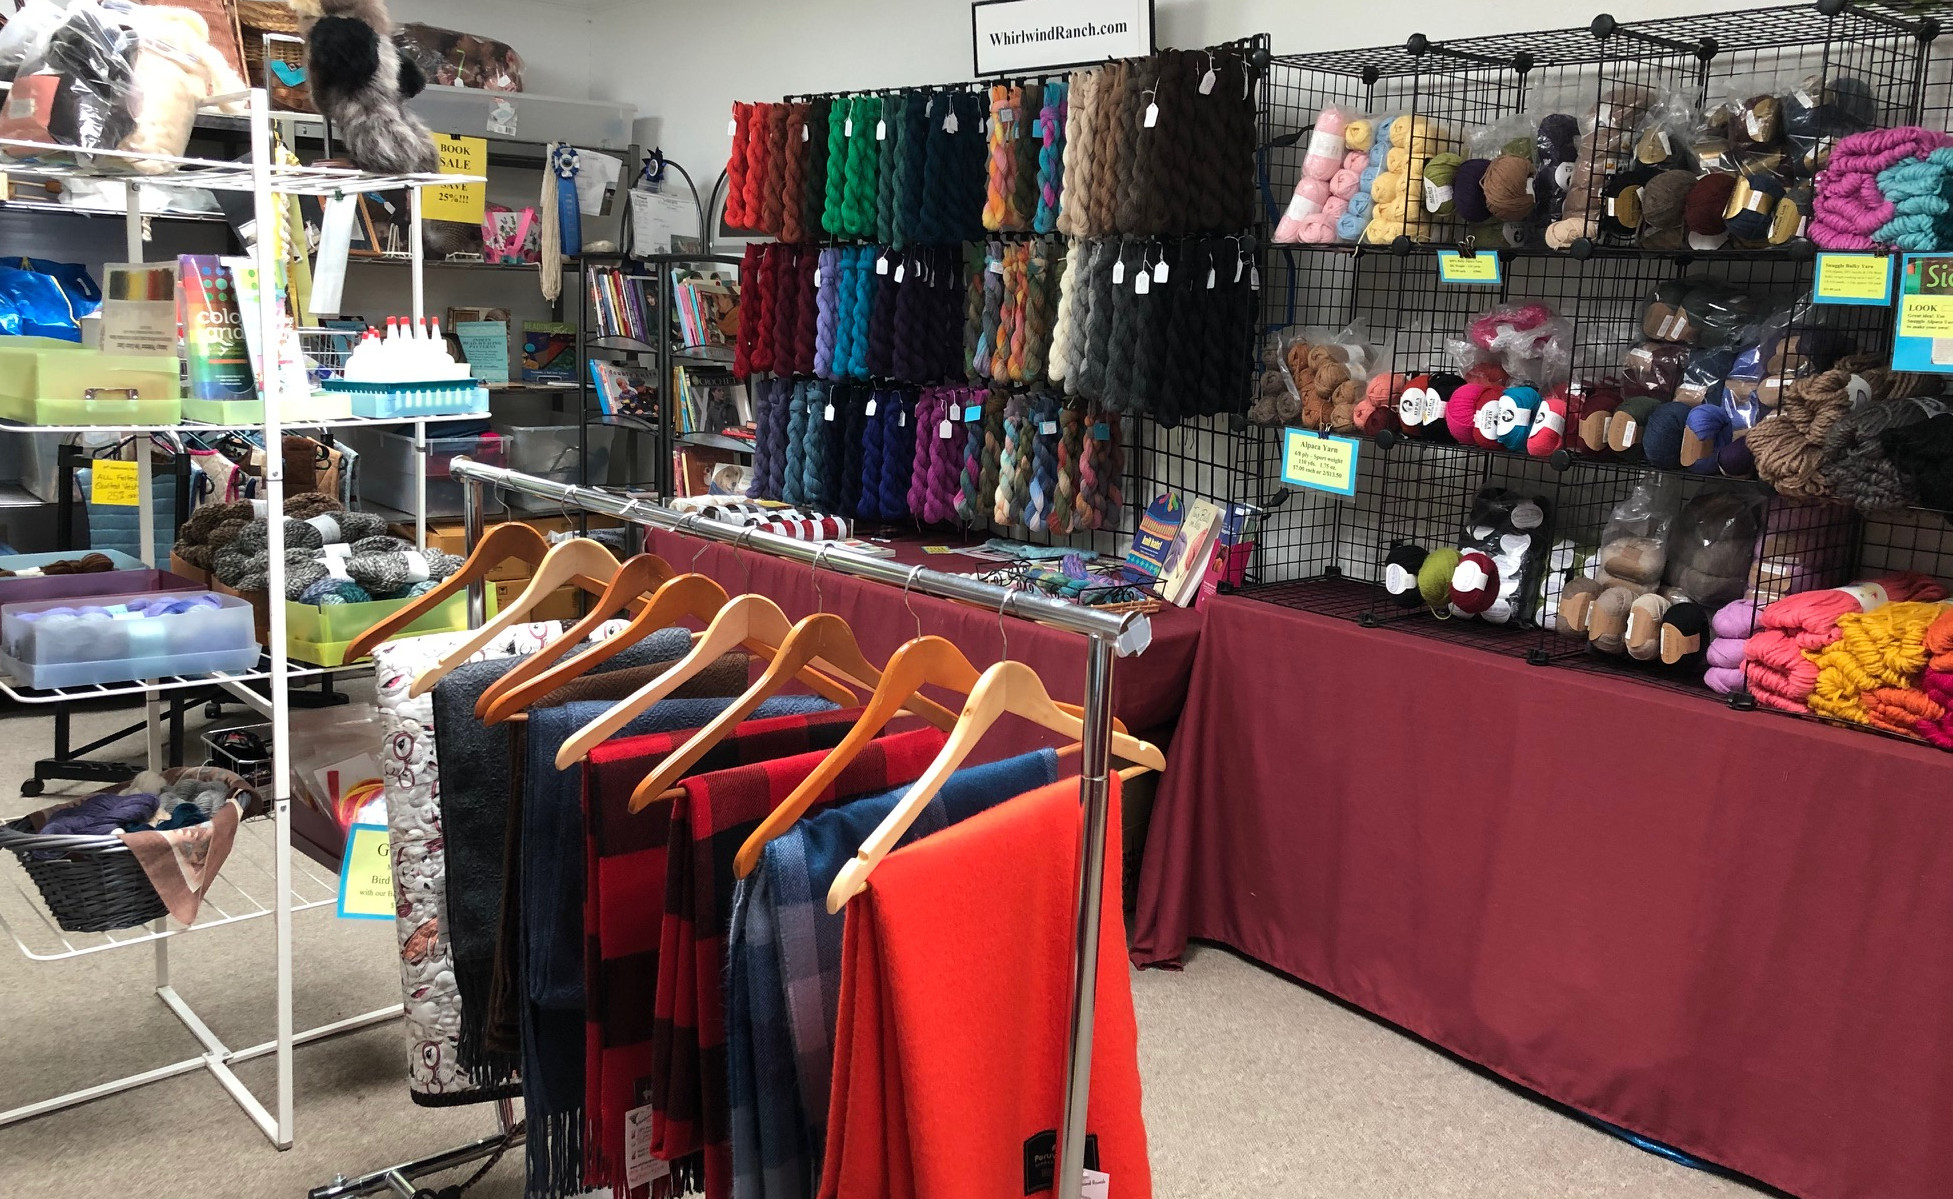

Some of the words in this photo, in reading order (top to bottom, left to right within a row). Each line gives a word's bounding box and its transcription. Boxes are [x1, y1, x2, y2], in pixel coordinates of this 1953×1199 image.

[990, 22, 1128, 46] WhirlwindRanch.com
[440, 143, 471, 155] BOOK
[440, 157, 471, 170] SALE
[438, 192, 469, 203] 25%!!!
[1908, 304, 1937, 312] LOOK
[1300, 441, 1321, 450] Alpaca
[1323, 444, 1339, 454] Yarn
[1313, 453, 1327, 461] Sport
[1327, 457, 1344, 465] weight
[371, 875, 391, 885] Bird
[359, 889, 374, 897] with
